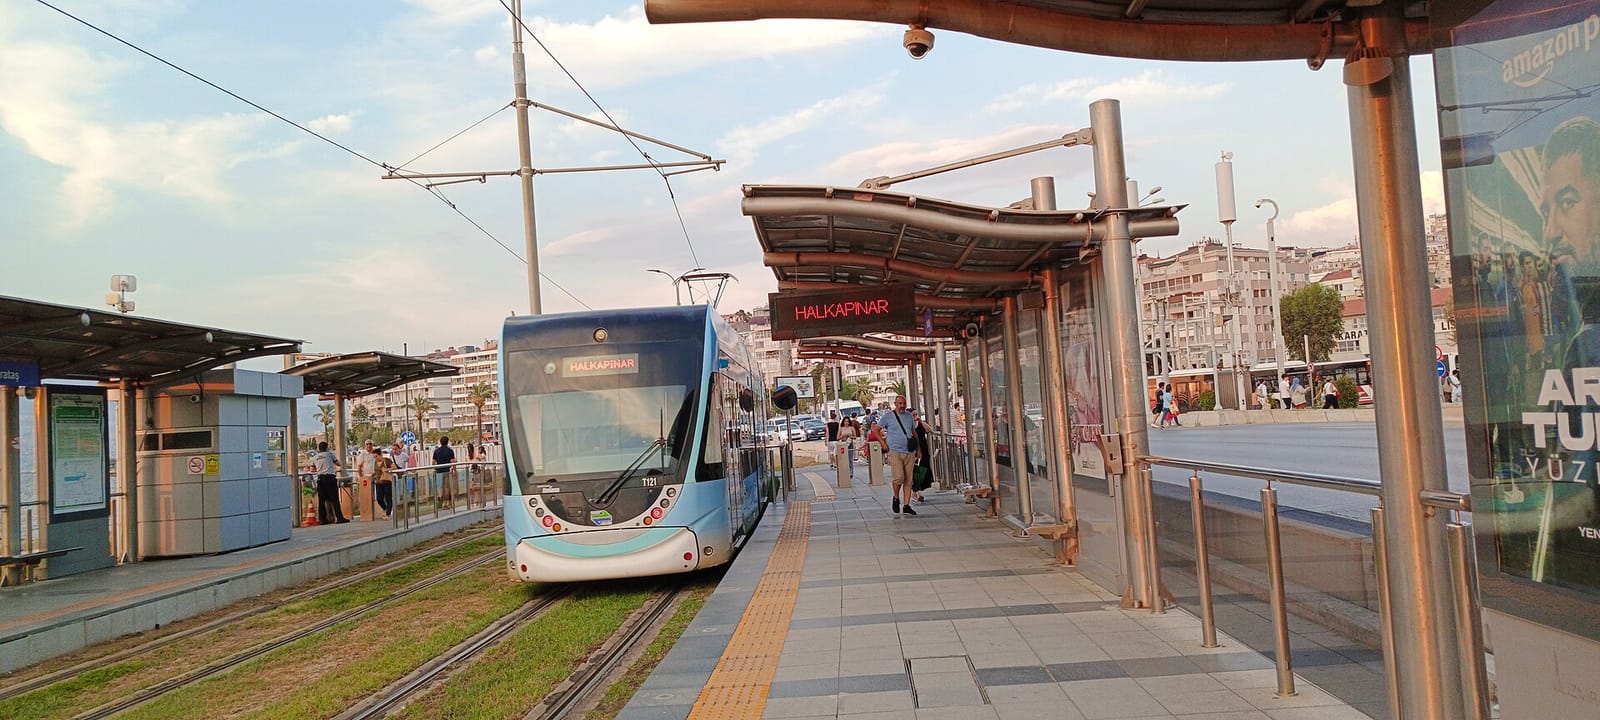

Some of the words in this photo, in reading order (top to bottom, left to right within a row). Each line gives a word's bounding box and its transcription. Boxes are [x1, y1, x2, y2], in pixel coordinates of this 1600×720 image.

[1503, 23, 1579, 83] amazon
[795, 299, 889, 320] HALKAPINAR
[570, 358, 635, 372] HALKAPINAR
[1522, 411, 1600, 451] TU
[642, 477, 657, 487] T121
[1526, 453, 1600, 485] YÜZ
